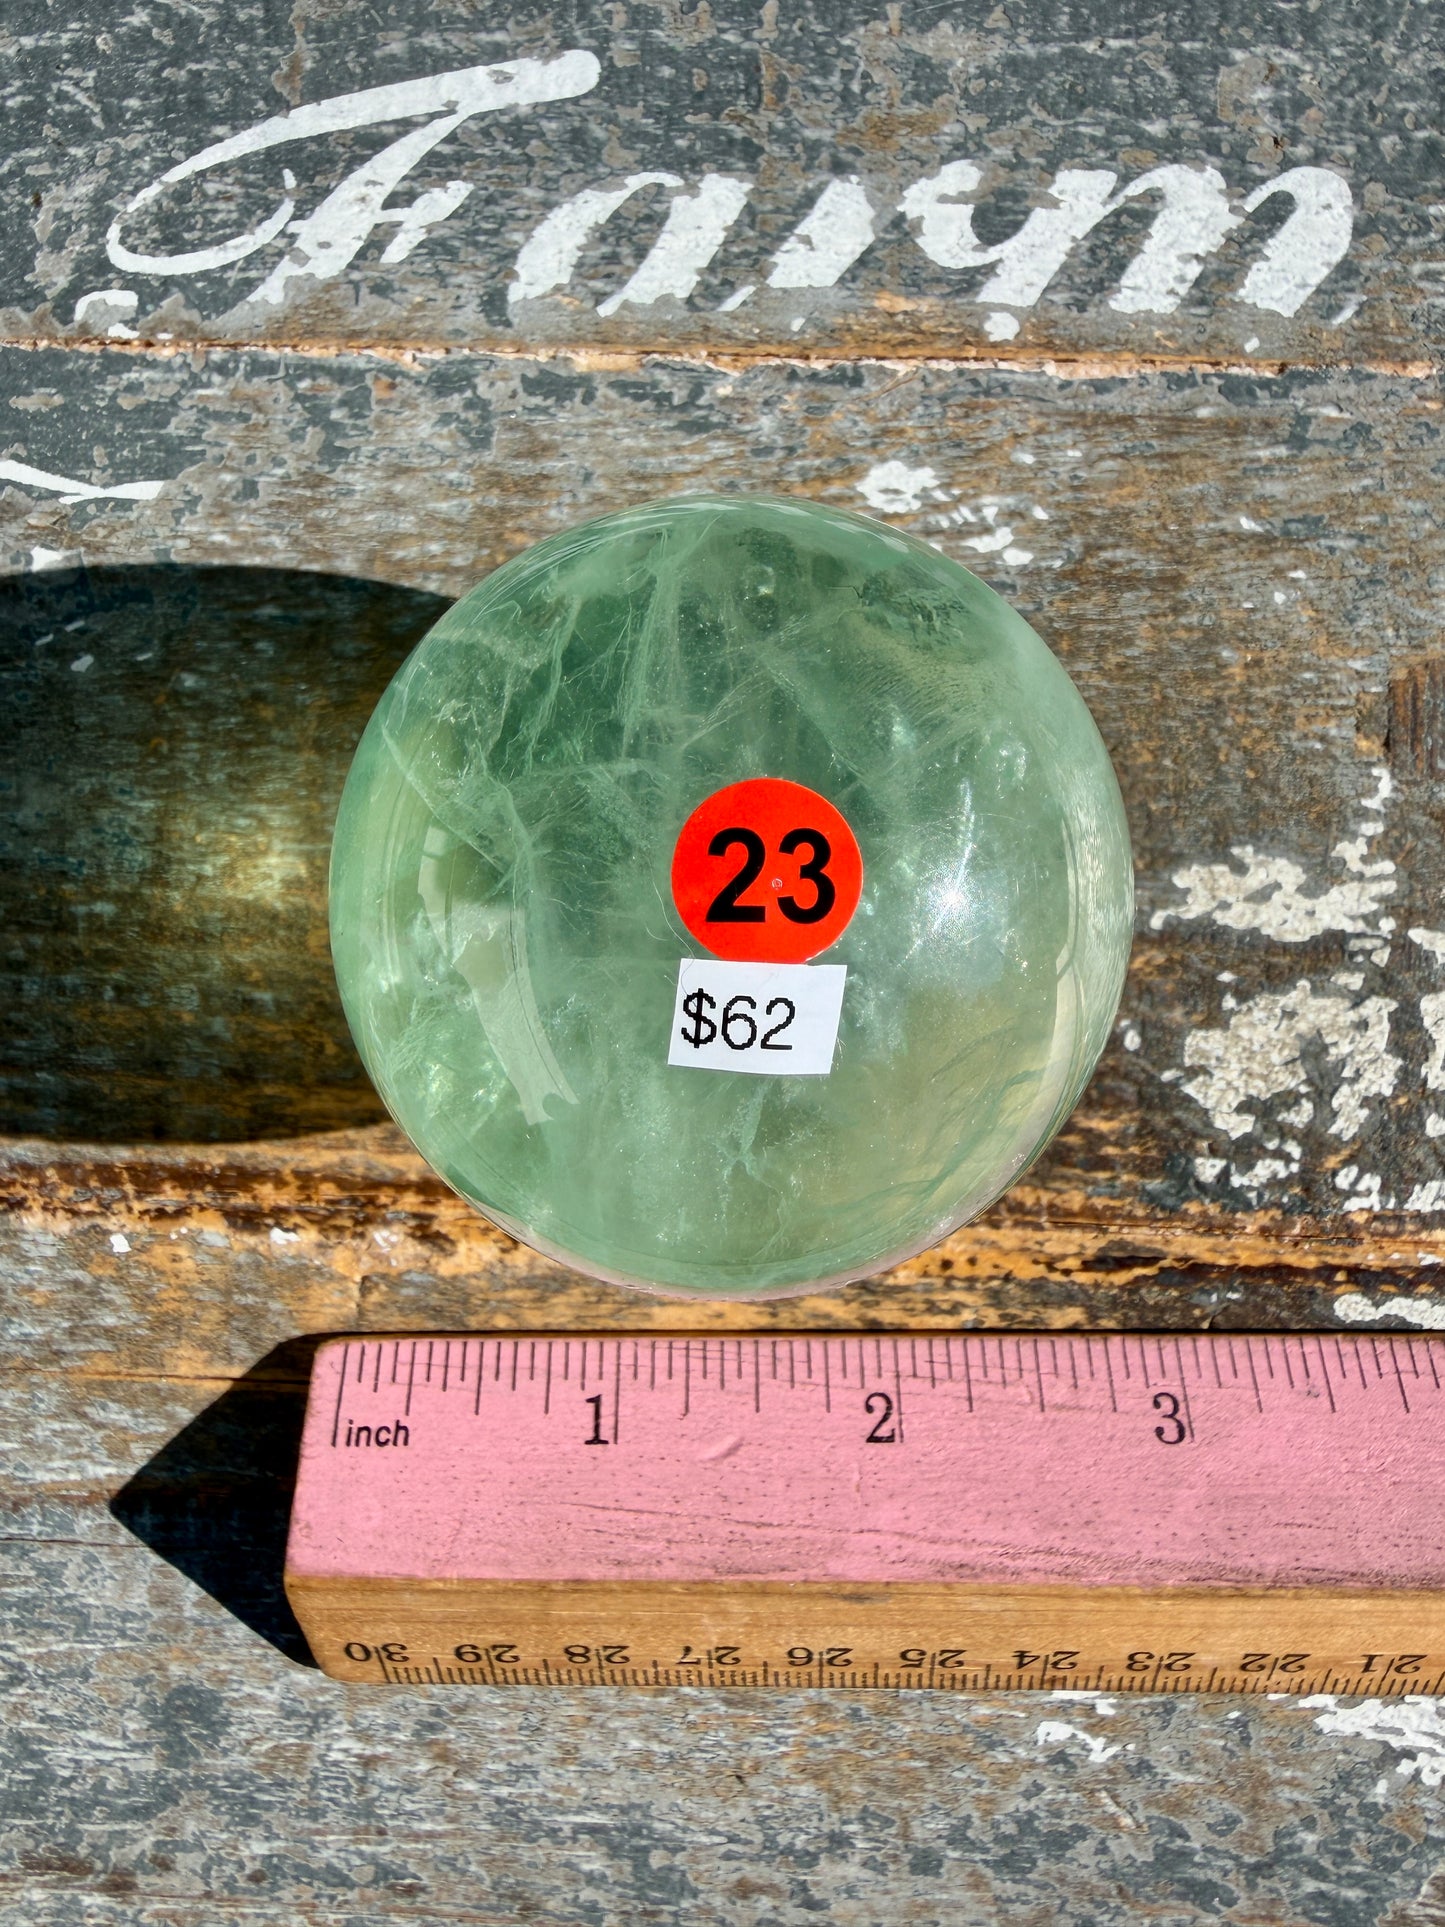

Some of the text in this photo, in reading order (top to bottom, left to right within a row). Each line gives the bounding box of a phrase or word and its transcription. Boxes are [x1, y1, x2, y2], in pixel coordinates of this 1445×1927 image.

[74, 48, 1364, 342] Farm
[705, 826, 836, 925] 23
[680, 987, 796, 1051] $62
[344, 1392, 1187, 1448] inch 1 2 3
[343, 1641, 1428, 1676] 21 22 23 24 25 26 27 28 29 30
